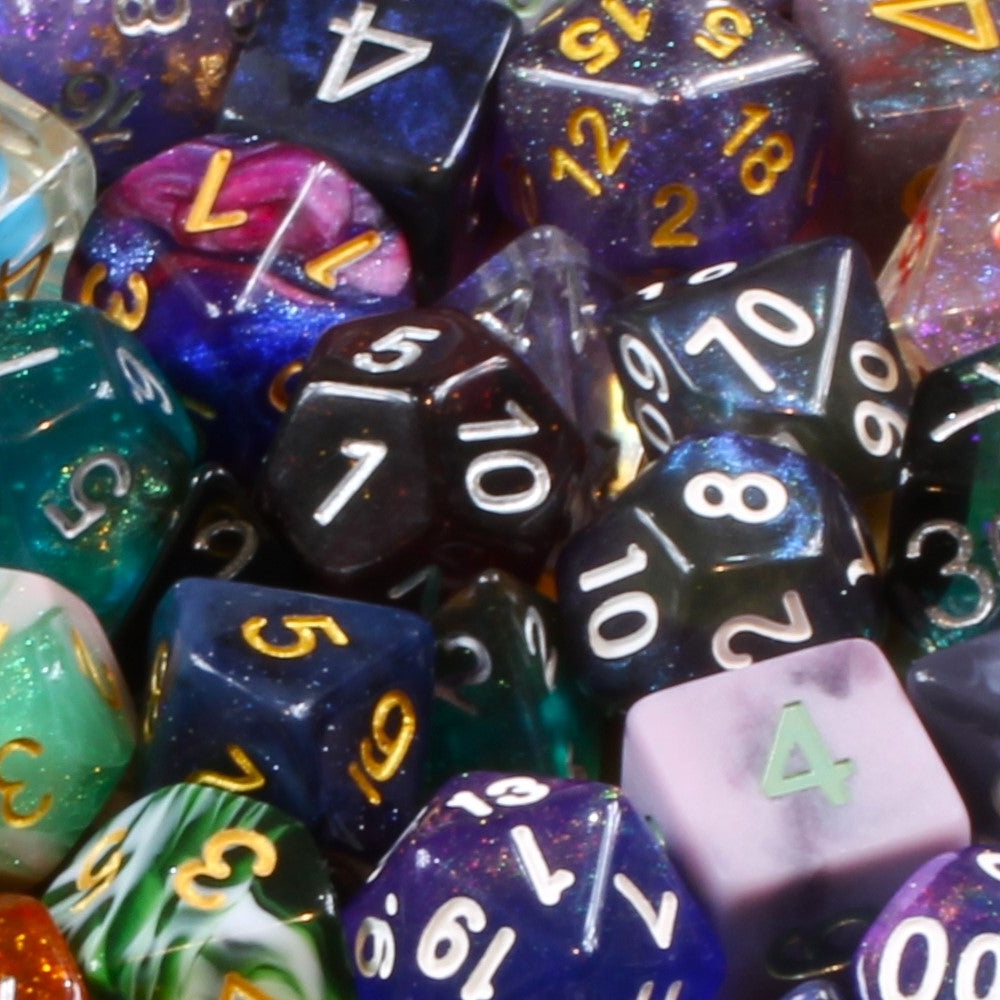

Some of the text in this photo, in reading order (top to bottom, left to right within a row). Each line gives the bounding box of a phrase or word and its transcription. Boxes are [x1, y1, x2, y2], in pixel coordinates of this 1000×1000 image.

[317, 2, 433, 102] 4
[184, 149, 249, 233] 7
[551, 107, 629, 196] 12
[722, 104, 794, 195] 18
[305, 229, 383, 290] 1
[651, 184, 699, 248] 2
[80, 263, 149, 331] 3
[684, 288, 815, 393] 70
[352, 326, 441, 373] 5
[43, 451, 132, 540] 5
[313, 438, 389, 526] 1
[457, 400, 552, 515] 10
[683, 472, 789, 524] 8
[578, 543, 659, 660] 10
[905, 518, 995, 629] 3
[240, 615, 349, 660] 5
[711, 589, 814, 671] 2
[761, 700, 858, 805] 4
[173, 827, 278, 911] 3
